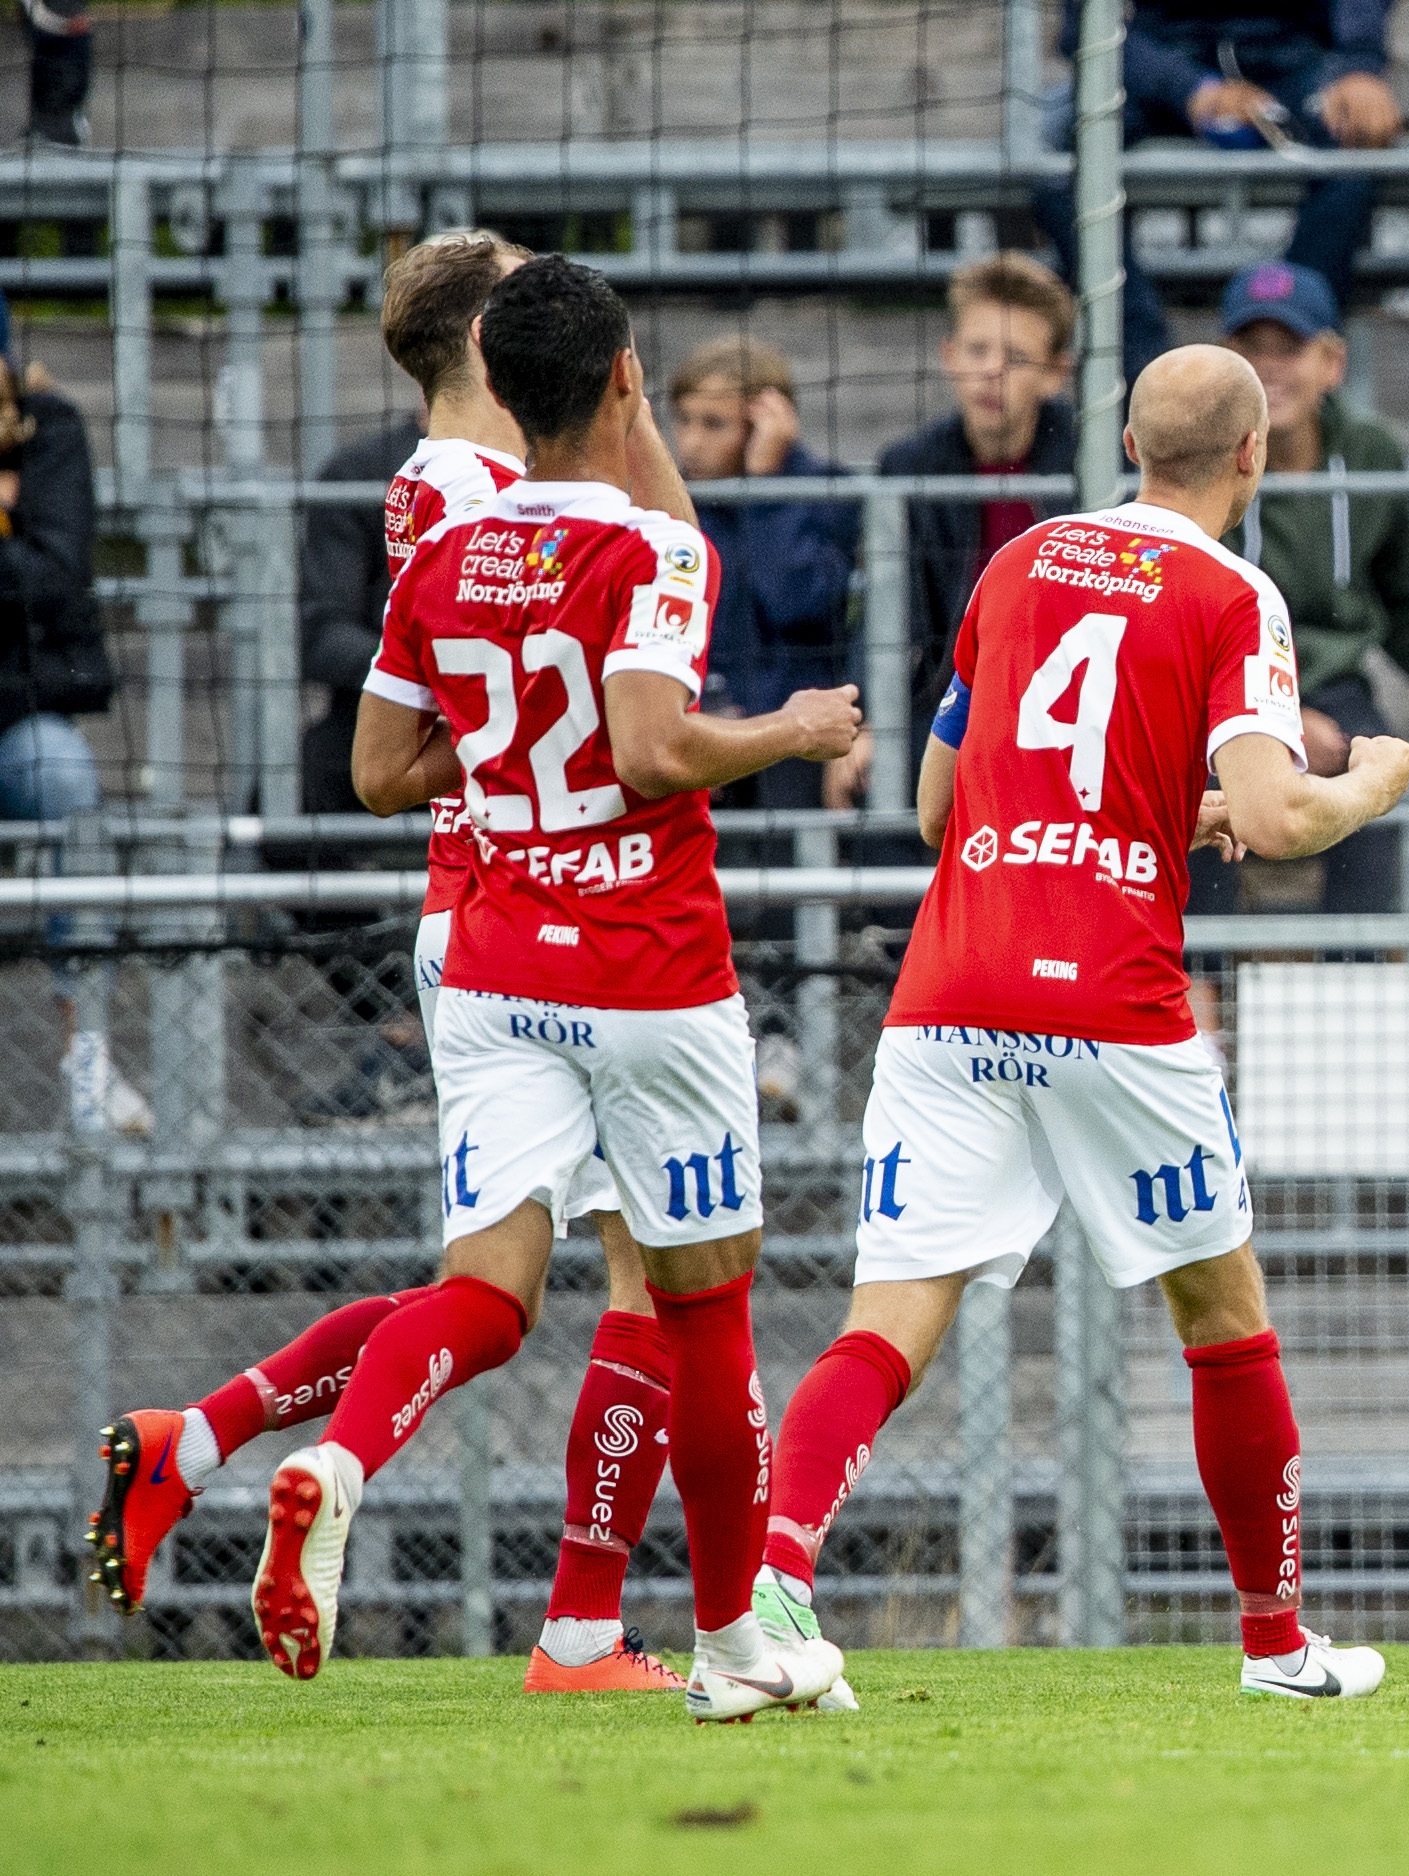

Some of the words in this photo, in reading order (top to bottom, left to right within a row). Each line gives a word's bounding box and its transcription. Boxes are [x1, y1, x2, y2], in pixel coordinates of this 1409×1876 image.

[516, 503, 556, 517] Smith
[465, 525, 526, 556] Let's
[1038, 540, 1117, 567] create
[1047, 523, 1111, 546] Let's
[461, 554, 525, 580] creat
[1027, 559, 1164, 604] Norrköping
[432, 628, 628, 834] 22
[1016, 612, 1128, 812] 4
[537, 924, 581, 948] PEKING
[1032, 957, 1079, 982] PEKING
[509, 1010, 597, 1049] RÖR
[970, 1051, 1052, 1088] RÖR
[662, 1131, 747, 1222] nt
[1129, 1144, 1219, 1226] nt
[391, 1378, 430, 1440] suez
[589, 1459, 622, 1542] suez
[1276, 1515, 1297, 1600] suez
